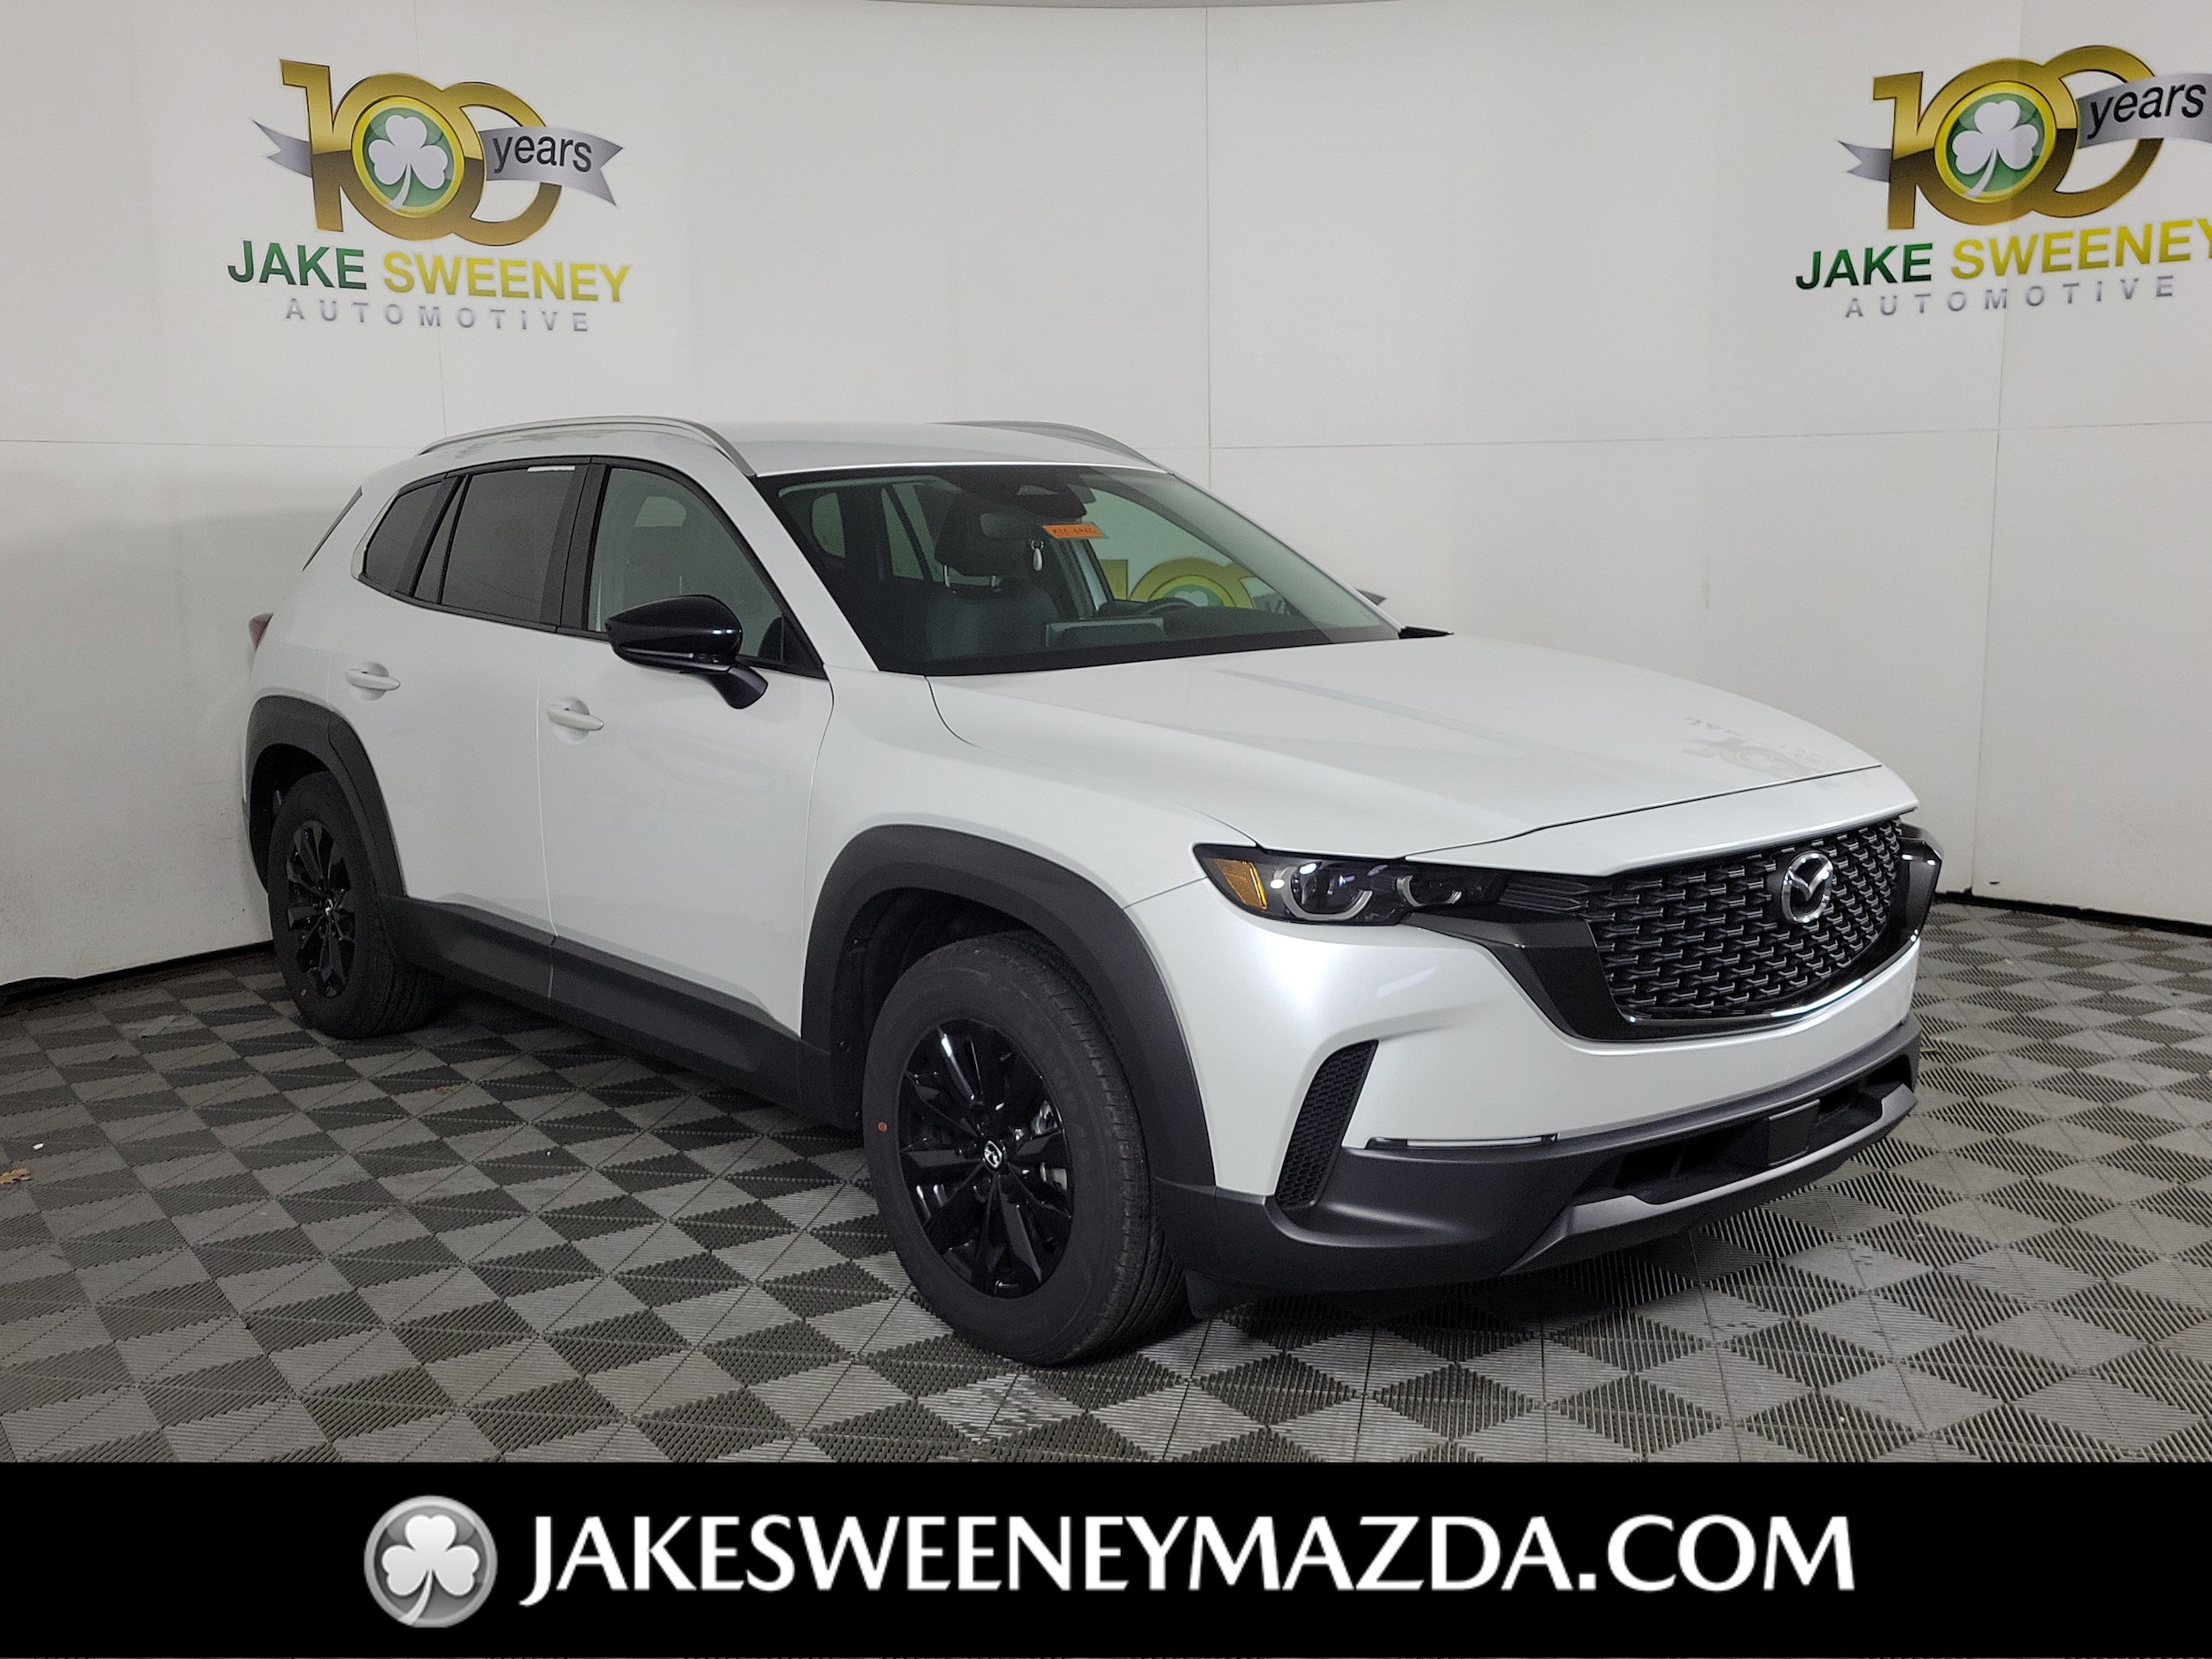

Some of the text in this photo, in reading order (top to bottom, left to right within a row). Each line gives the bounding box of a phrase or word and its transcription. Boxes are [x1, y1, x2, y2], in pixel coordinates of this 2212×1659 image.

[279, 58, 593, 246] 100 years
[1872, 44, 2207, 231] 100 years
[227, 240, 632, 303] JAKE SWEENEY
[1795, 242, 1934, 291] JAKE
[285, 297, 588, 333] AUTOMOTIVE
[1844, 274, 2176, 319] AUTOMOTIVE
